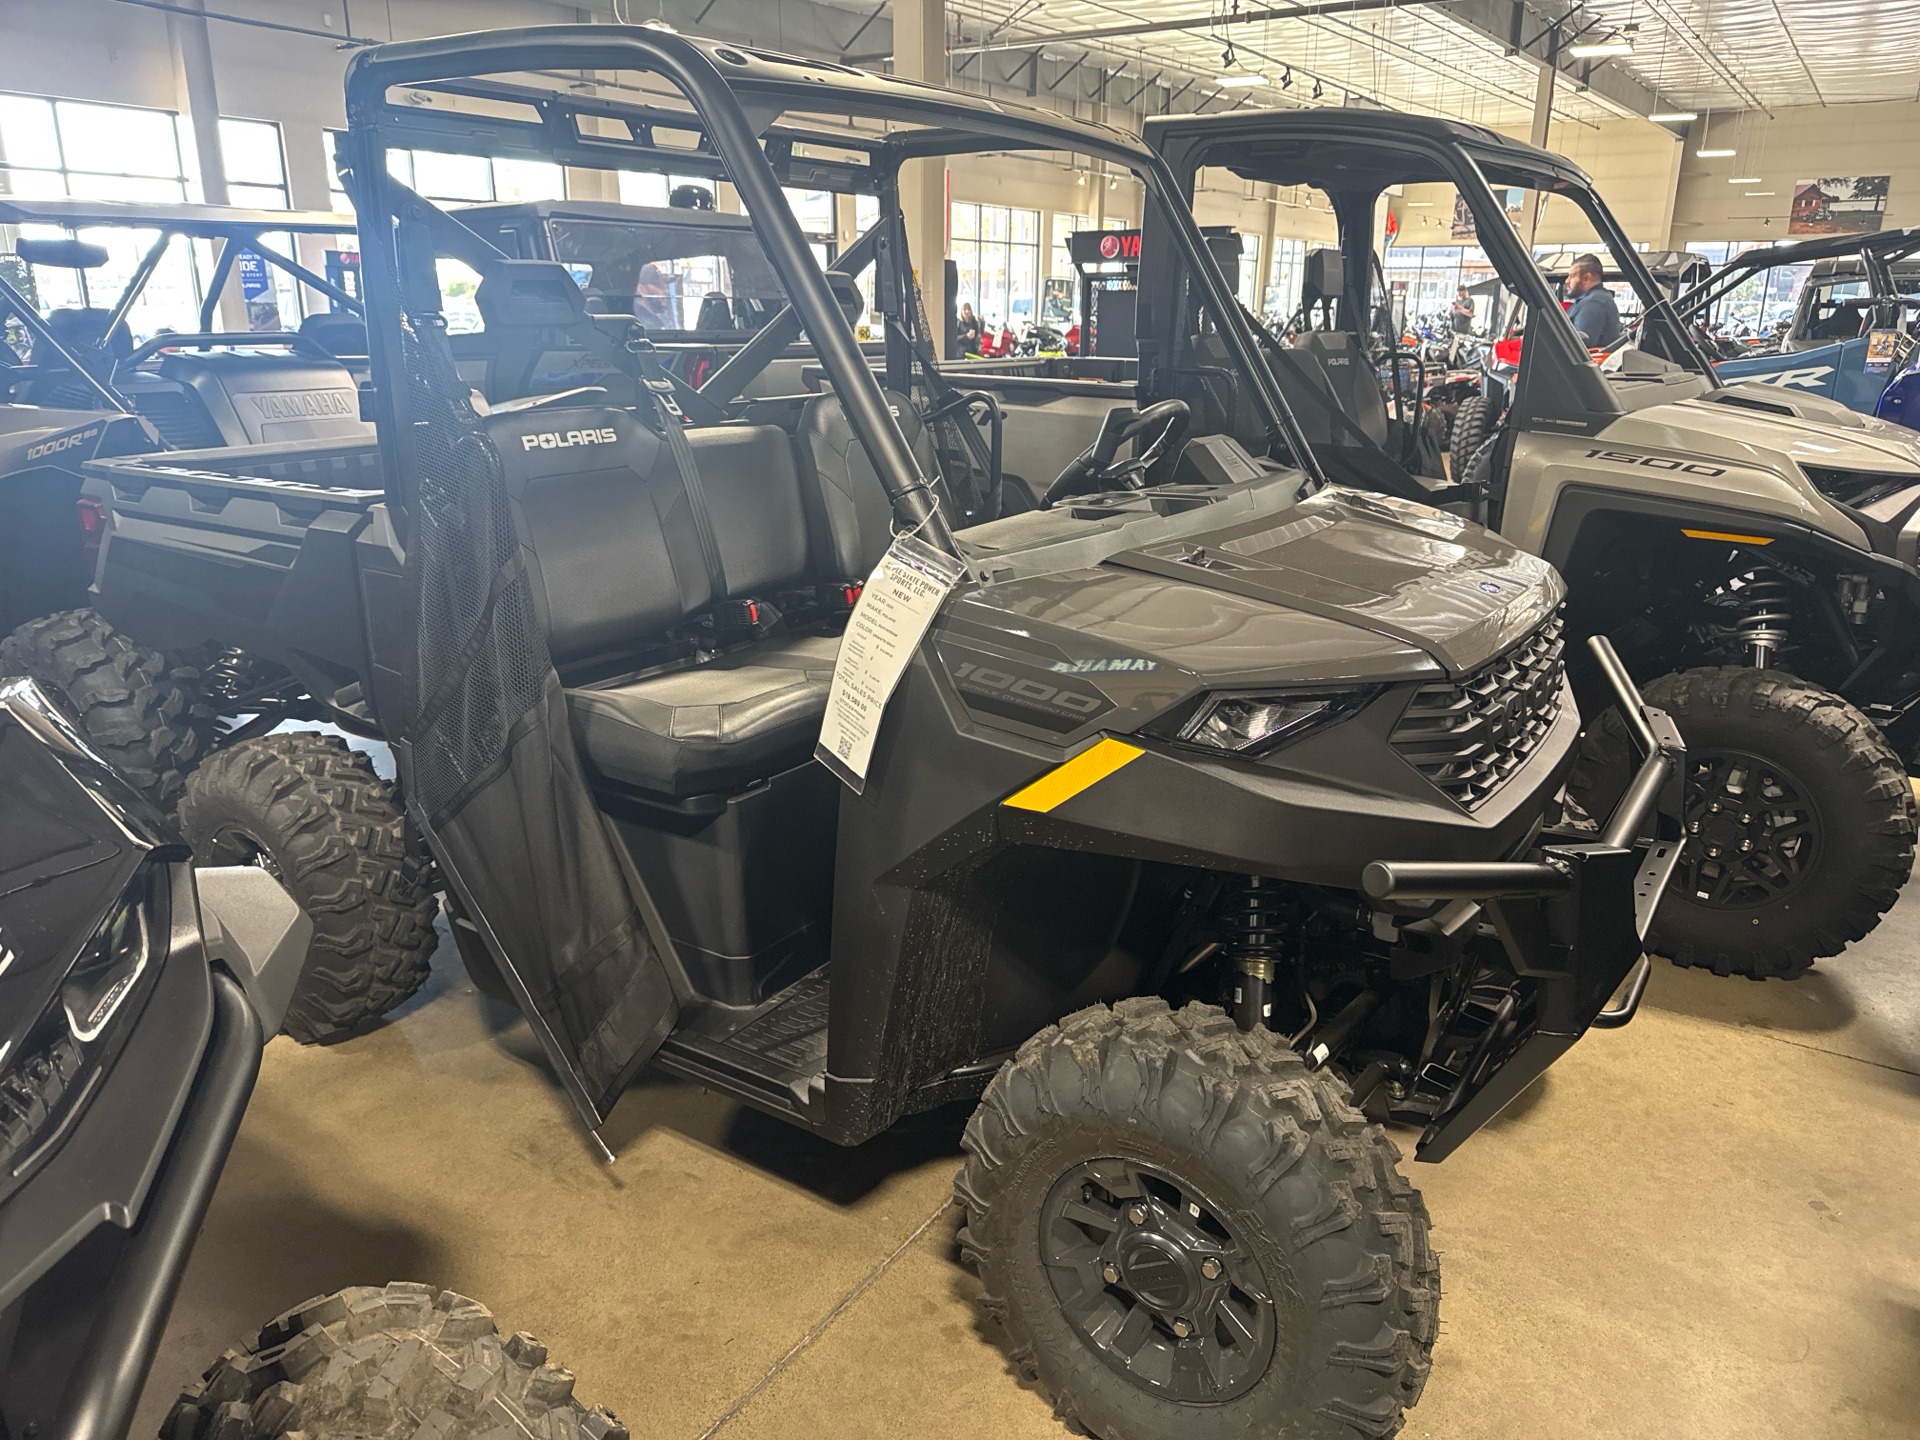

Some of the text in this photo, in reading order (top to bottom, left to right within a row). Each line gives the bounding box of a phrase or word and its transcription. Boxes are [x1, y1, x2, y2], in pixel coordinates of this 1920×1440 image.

[239, 261, 259, 271] IDE
[1327, 357, 1350, 366] POLARIS
[1721, 365, 1836, 389] ZR
[250, 392, 352, 419] YAMAHA
[26, 432, 83, 461] 1000R
[520, 427, 618, 452] POLARIS
[1584, 449, 1727, 478] 1500
[891, 588, 912, 603] NEW
[850, 682, 867, 698] SALES
[866, 694, 883, 710] PRICE
[954, 661, 1102, 713] 1000
[961, 682, 1087, 721] SINGLE OVERHEAD CAM
